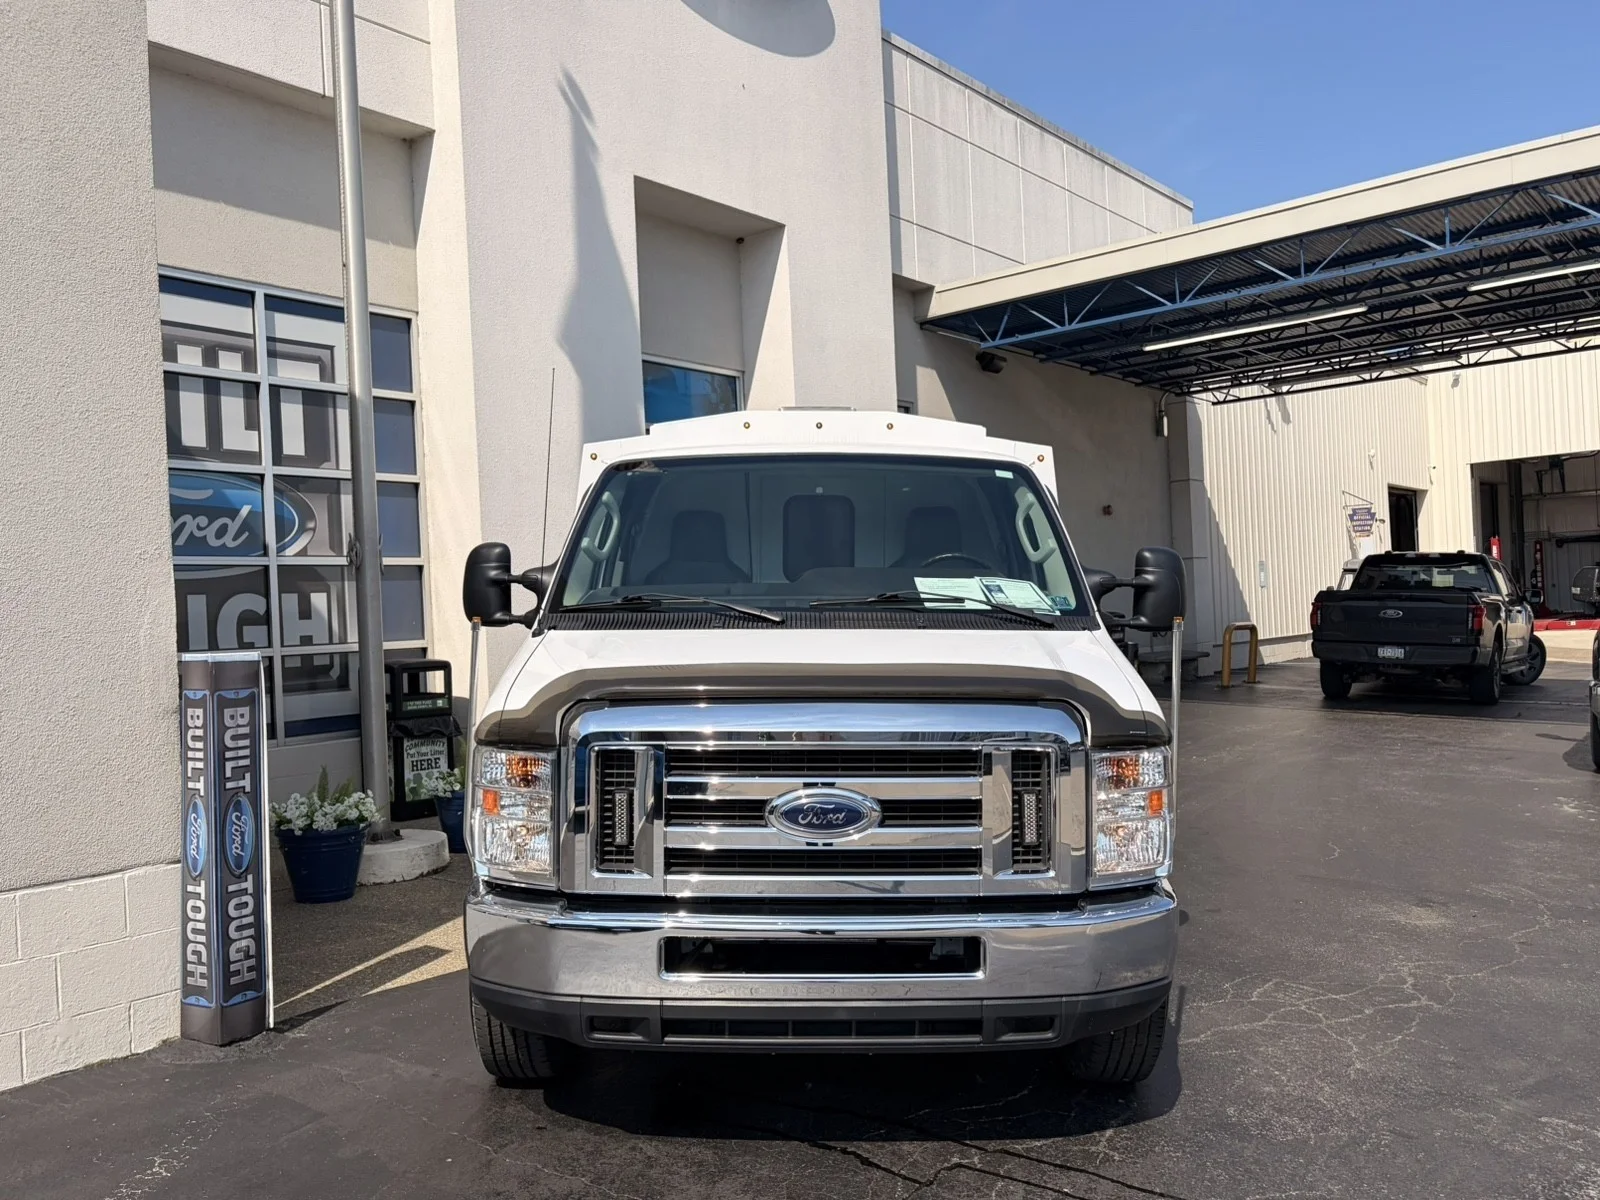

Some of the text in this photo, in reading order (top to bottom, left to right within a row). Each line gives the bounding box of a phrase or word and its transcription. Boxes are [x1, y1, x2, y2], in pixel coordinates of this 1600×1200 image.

[169, 488, 252, 548] rd
[405, 739, 446, 753] COMMUNITY
[416, 750, 429, 758] Your
[411, 757, 441, 773] HERE
[798, 803, 847, 825] Ford
[186, 707, 208, 988] BUILT Ford TOUGH
[223, 706, 257, 986] BUILT Ford TOUGH
